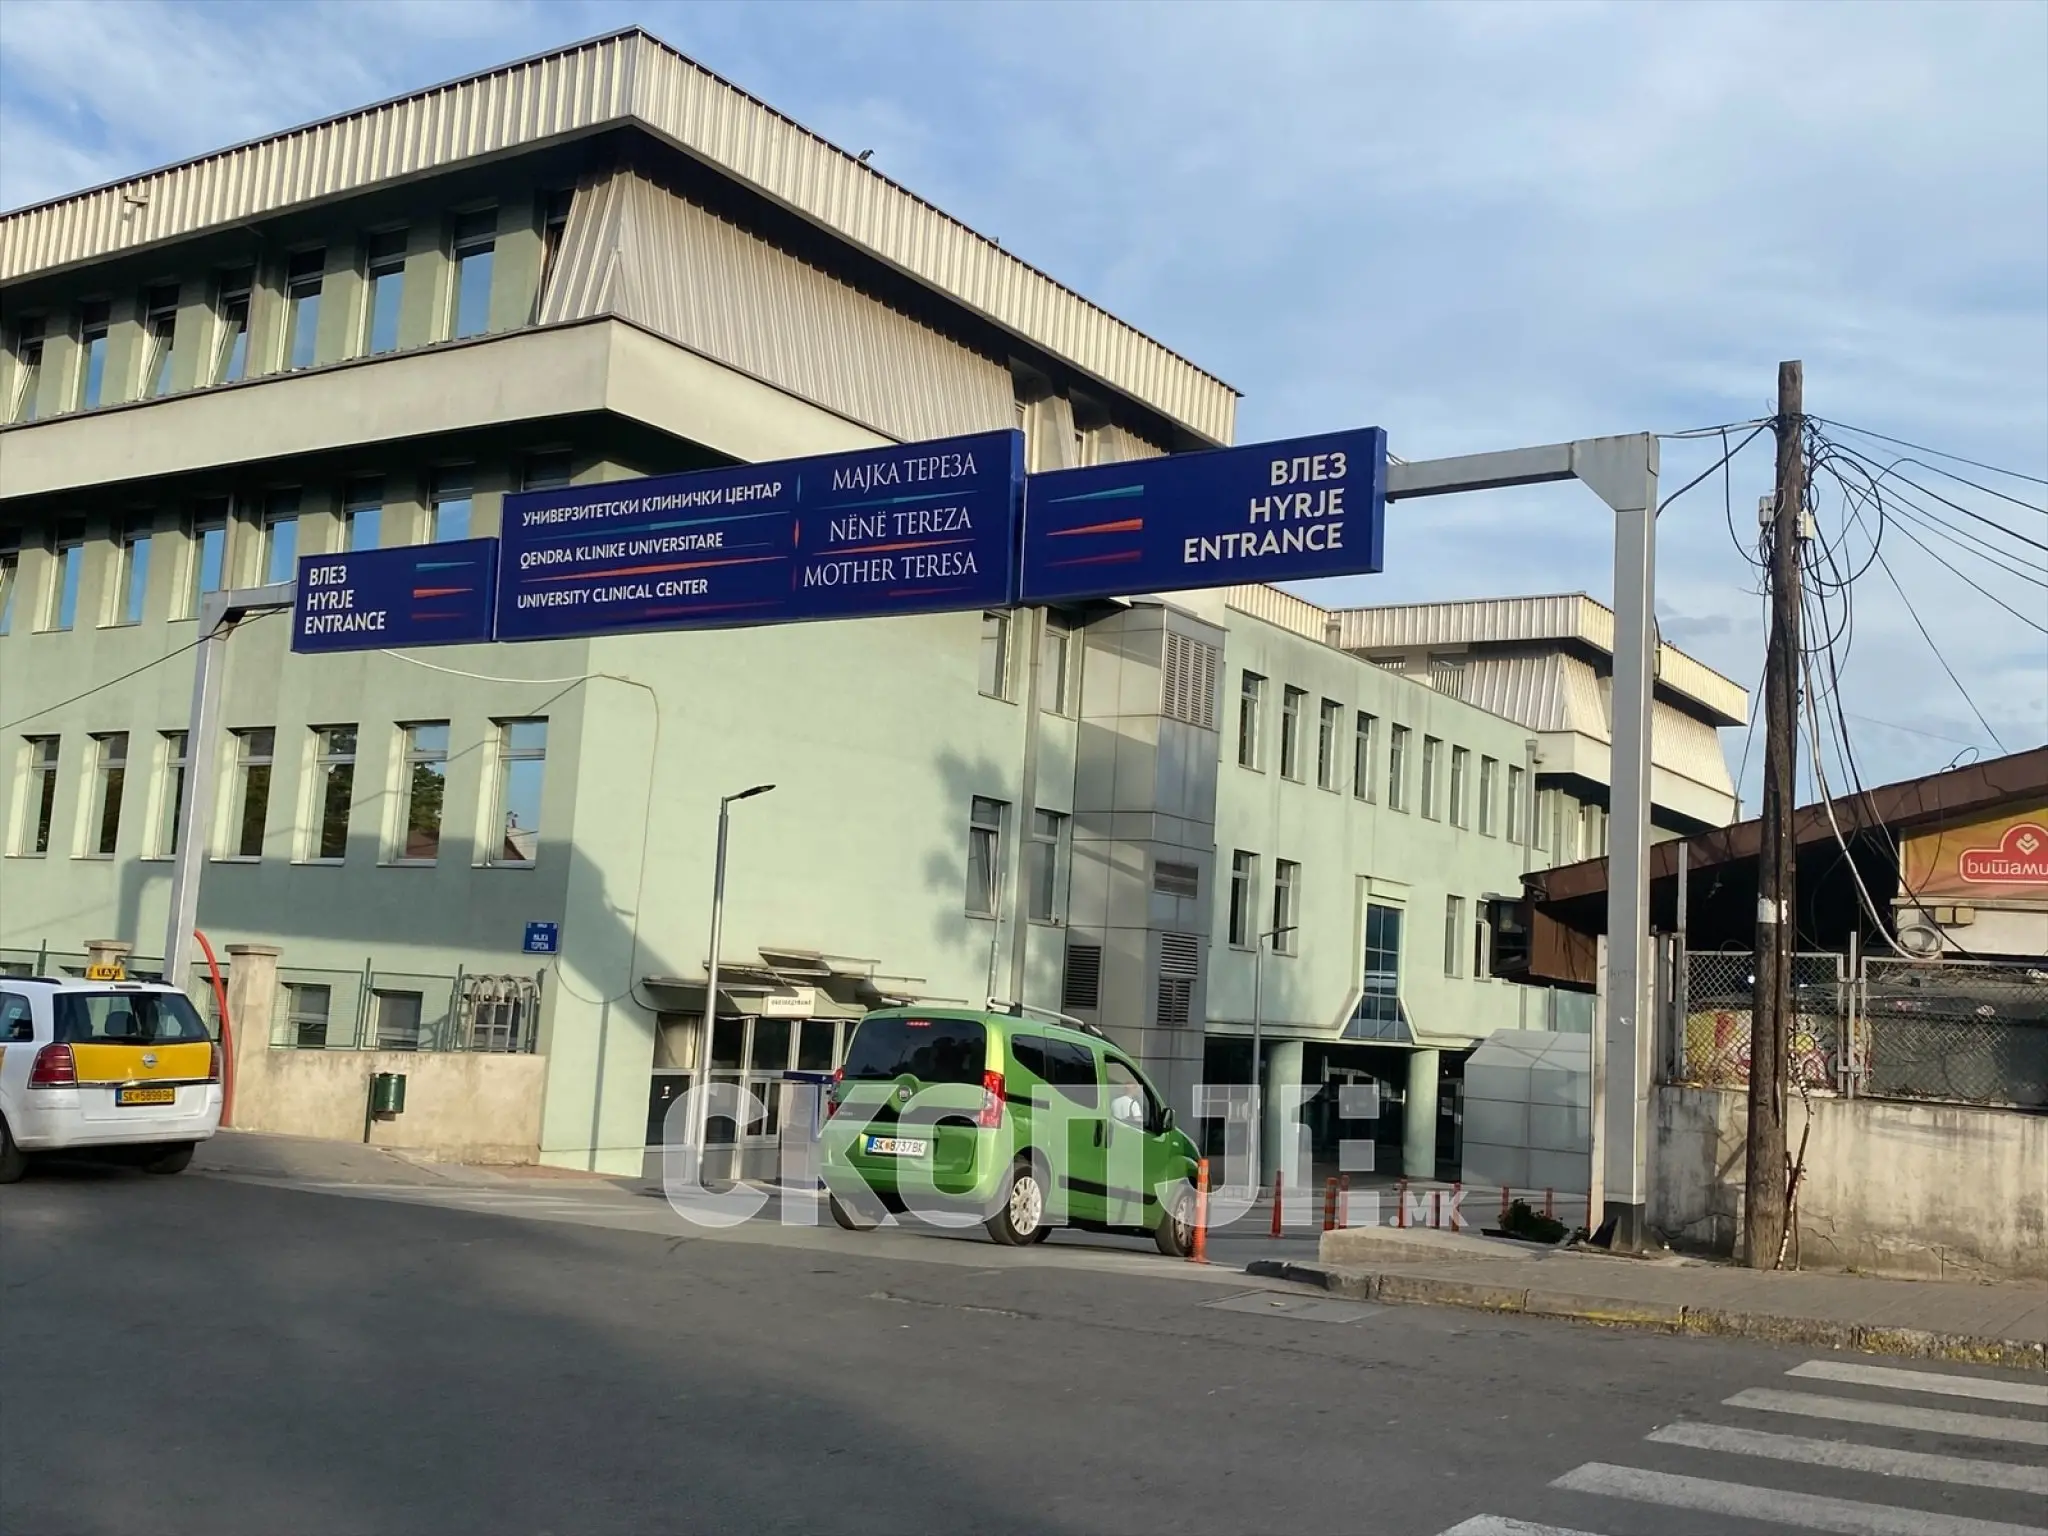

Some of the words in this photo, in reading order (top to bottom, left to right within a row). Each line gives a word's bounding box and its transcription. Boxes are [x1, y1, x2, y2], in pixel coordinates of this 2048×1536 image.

[832, 462, 900, 493] МАЈКА
[904, 452, 978, 482] ТЕРЕЗА
[1270, 452, 1347, 486] ВЛЕЗ
[522, 499, 640, 526] УНИВЕРЗИТЕТСКИ
[642, 489, 722, 512] КЛИНИЧКИ
[725, 482, 782, 505] ЦЕНТАР
[1250, 488, 1345, 524] HYRJE
[829, 510, 887, 542] NËNË
[893, 506, 973, 535] TEREZA
[520, 548, 573, 569] QENDRA
[576, 542, 626, 561] KLINIKE
[629, 532, 724, 555] UNIVERSITARE
[1184, 522, 1344, 563] ENTRANCE
[309, 565, 347, 586] ВЛЕЗ
[803, 558, 896, 588] MOTHER
[900, 551, 978, 579] TERESA
[306, 589, 355, 611] HYRJE
[517, 589, 591, 608] UNIVERSITY
[593, 584, 653, 603] CLINICAL
[656, 579, 708, 597] CENTER
[304, 611, 386, 634] ENTRANCE
